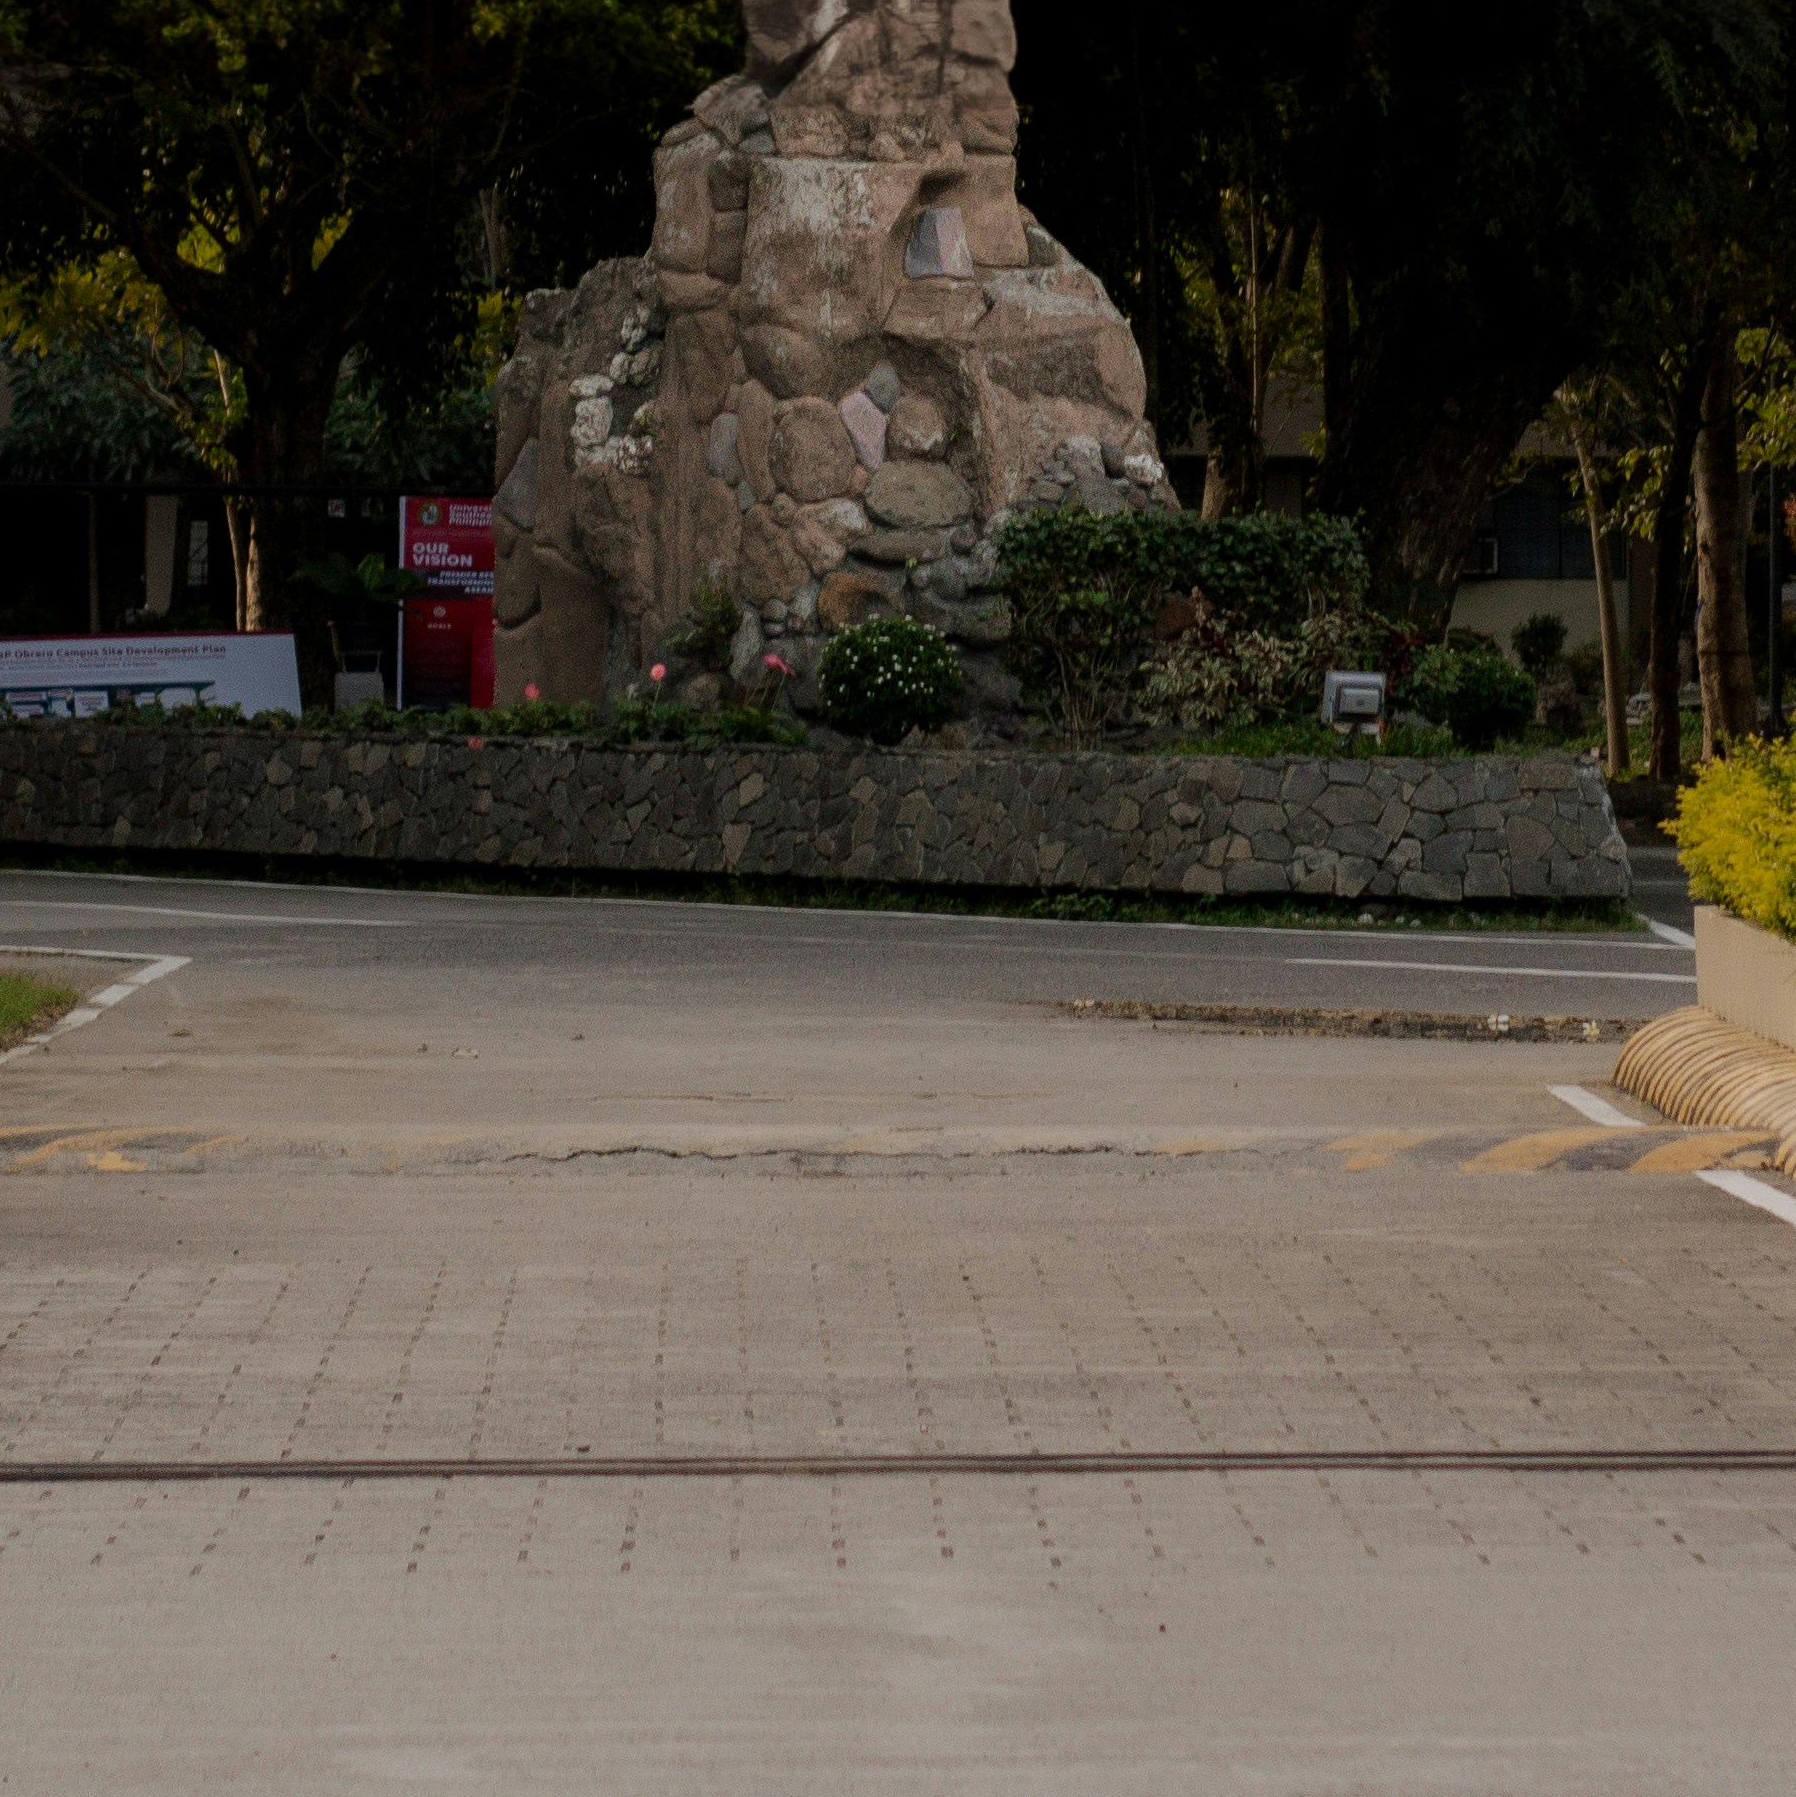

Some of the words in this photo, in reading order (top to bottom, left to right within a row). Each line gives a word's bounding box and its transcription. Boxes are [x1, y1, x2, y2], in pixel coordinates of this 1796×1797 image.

[412, 542, 449, 554] OUR
[412, 553, 473, 567] VISION
[14, 649, 53, 659] Obrero
[56, 647, 99, 659] Campus
[101, 646, 123, 656] Site
[126, 644, 200, 657] Development
[202, 643, 226, 654] Plan
